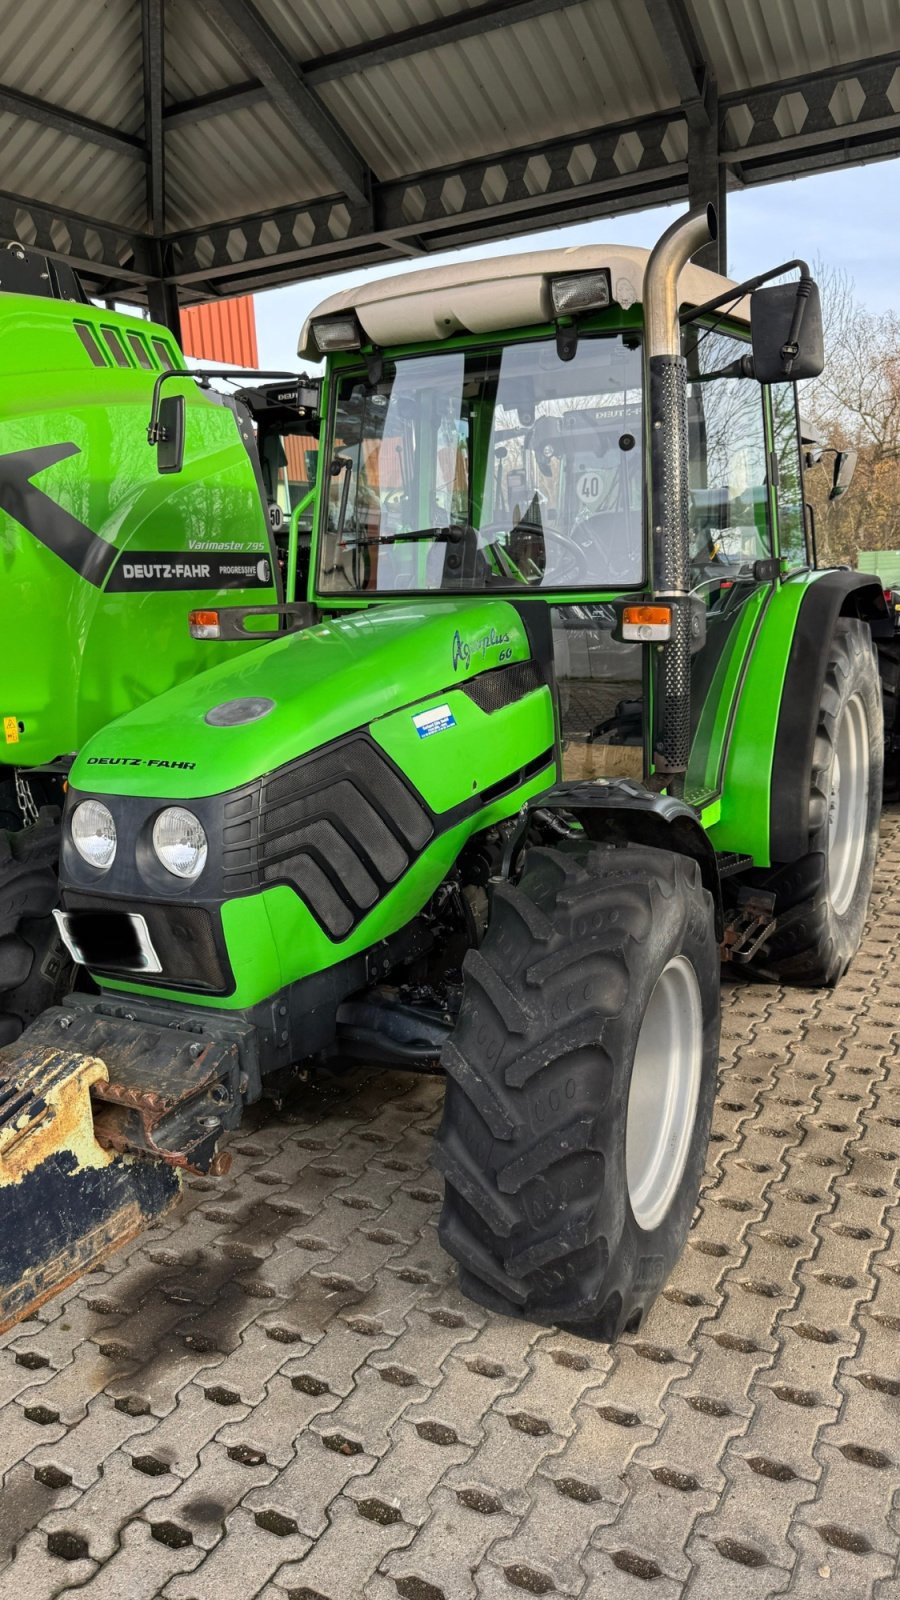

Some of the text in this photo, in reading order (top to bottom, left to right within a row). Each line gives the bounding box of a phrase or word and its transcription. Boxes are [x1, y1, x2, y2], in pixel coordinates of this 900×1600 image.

[582, 477, 599, 498] 40
[270, 508, 281, 526] 50
[188, 540, 265, 551] Varimaster 795
[122, 564, 211, 579] DEUTZ-FAHR
[219, 565, 257, 575] PROGRESSIVE
[499, 647, 512, 661] 60
[86, 757, 196, 770] DEUTZ-FAHR
